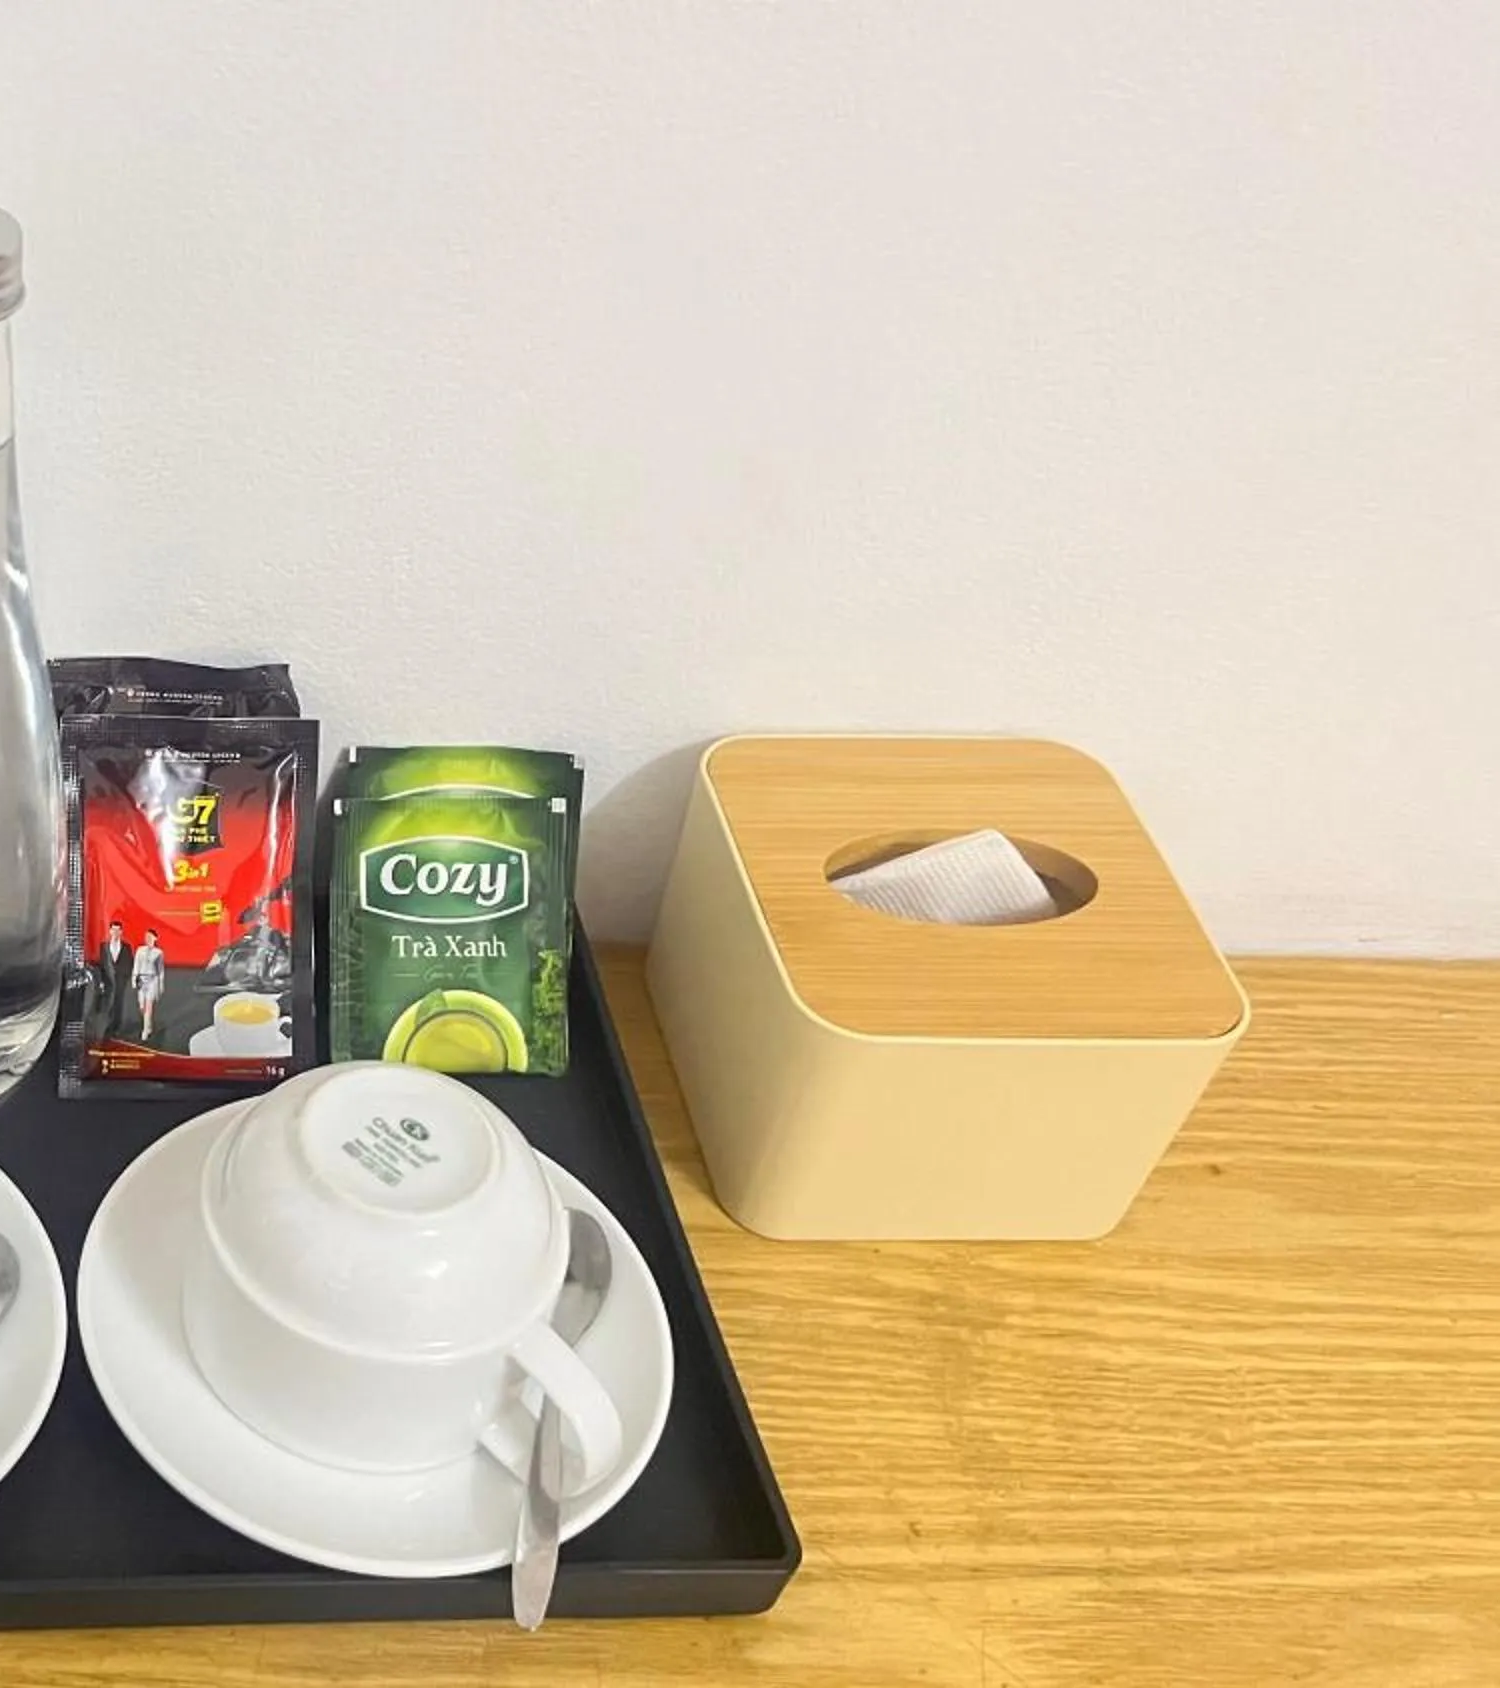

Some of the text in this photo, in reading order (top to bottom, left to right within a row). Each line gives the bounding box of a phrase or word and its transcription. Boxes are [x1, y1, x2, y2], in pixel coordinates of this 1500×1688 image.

[379, 853, 509, 906] Cozy
[391, 934, 507, 958] Trà Xanh
